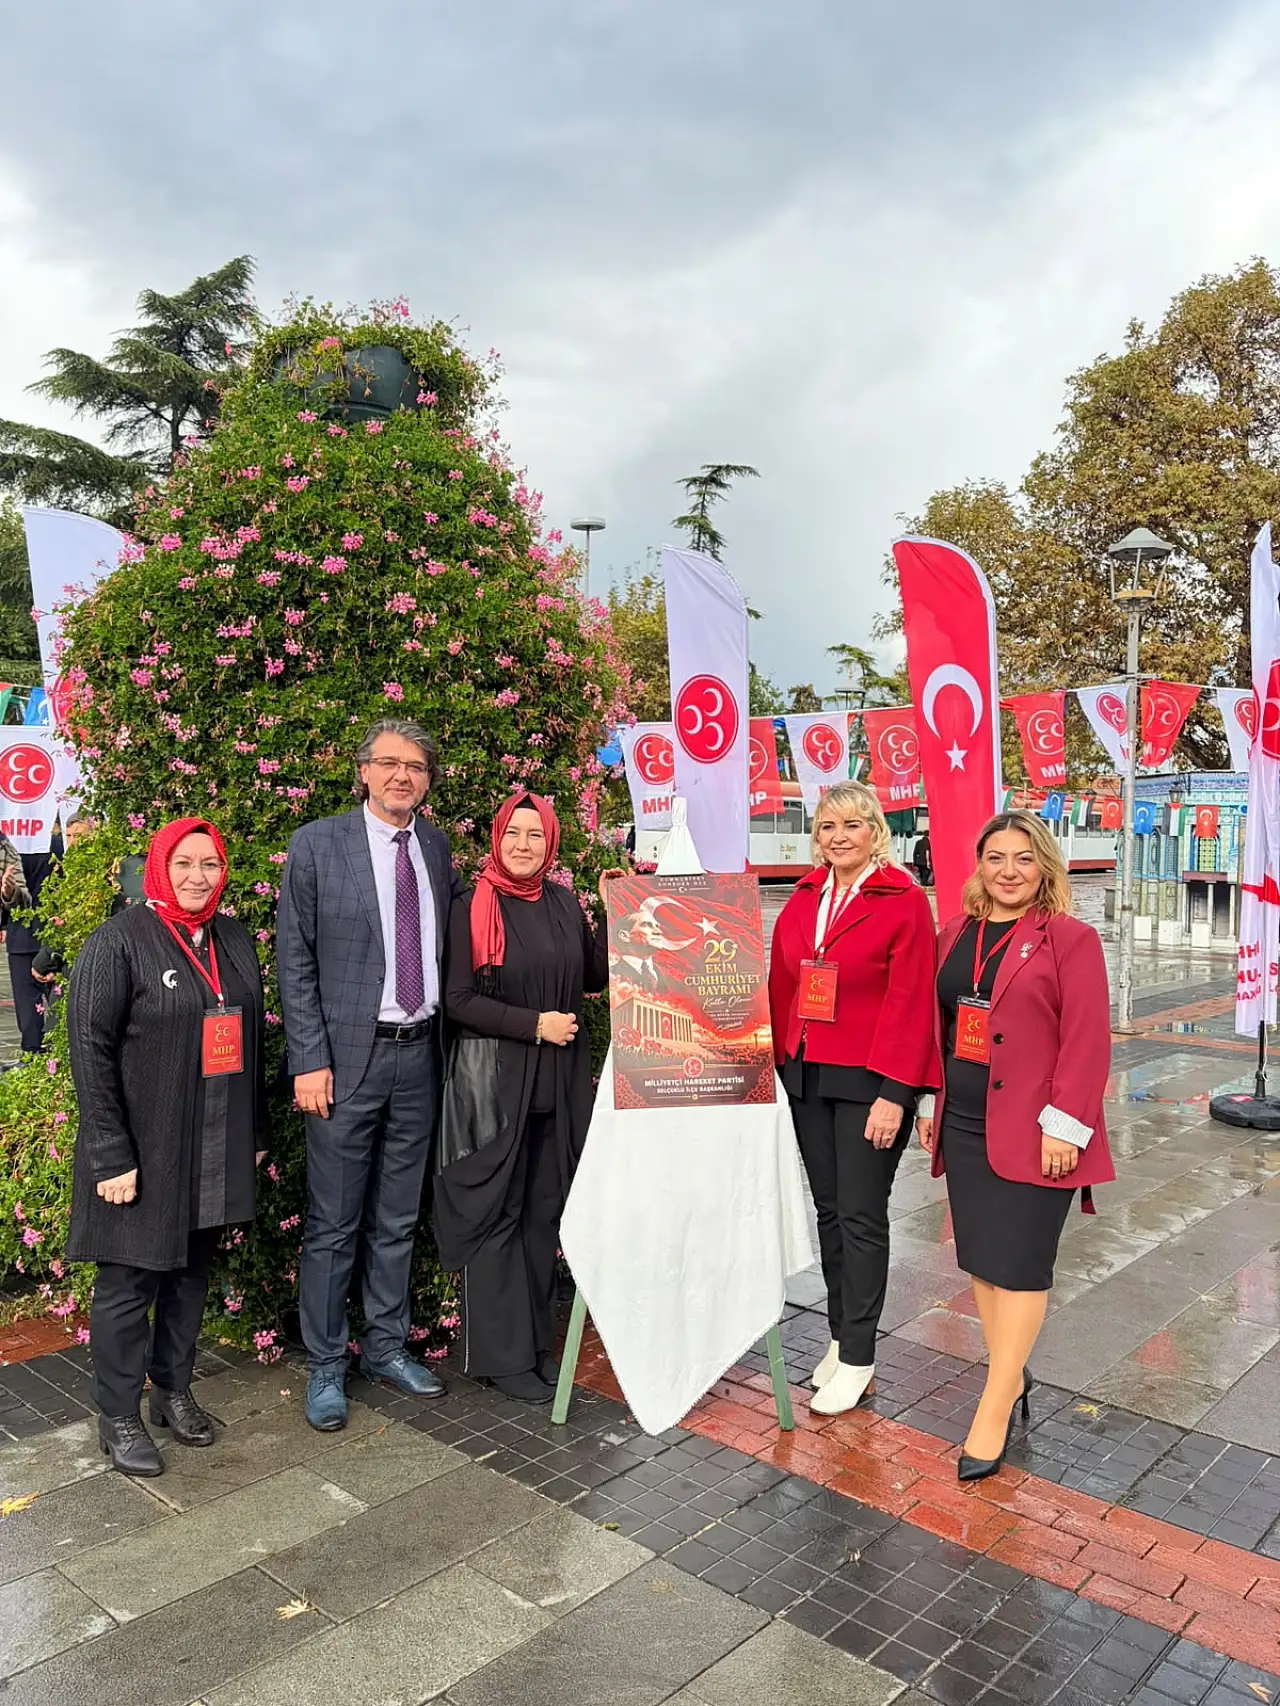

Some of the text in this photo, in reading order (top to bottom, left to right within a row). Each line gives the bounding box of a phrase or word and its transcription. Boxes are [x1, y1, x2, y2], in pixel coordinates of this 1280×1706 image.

[1040, 762, 1066, 778] MH
[704, 939, 738, 963] 29
[705, 962, 737, 974] EKİM
[683, 973, 761, 986] CUMHURİYET
[698, 984, 752, 996] BAYRAMI
[807, 993, 828, 1003] MHP
[963, 1034, 984, 1046] MHP
[213, 1045, 235, 1056] MHP
[684, 1077, 716, 1086] HAREKET
[718, 1075, 745, 1084] PARTİSİ
